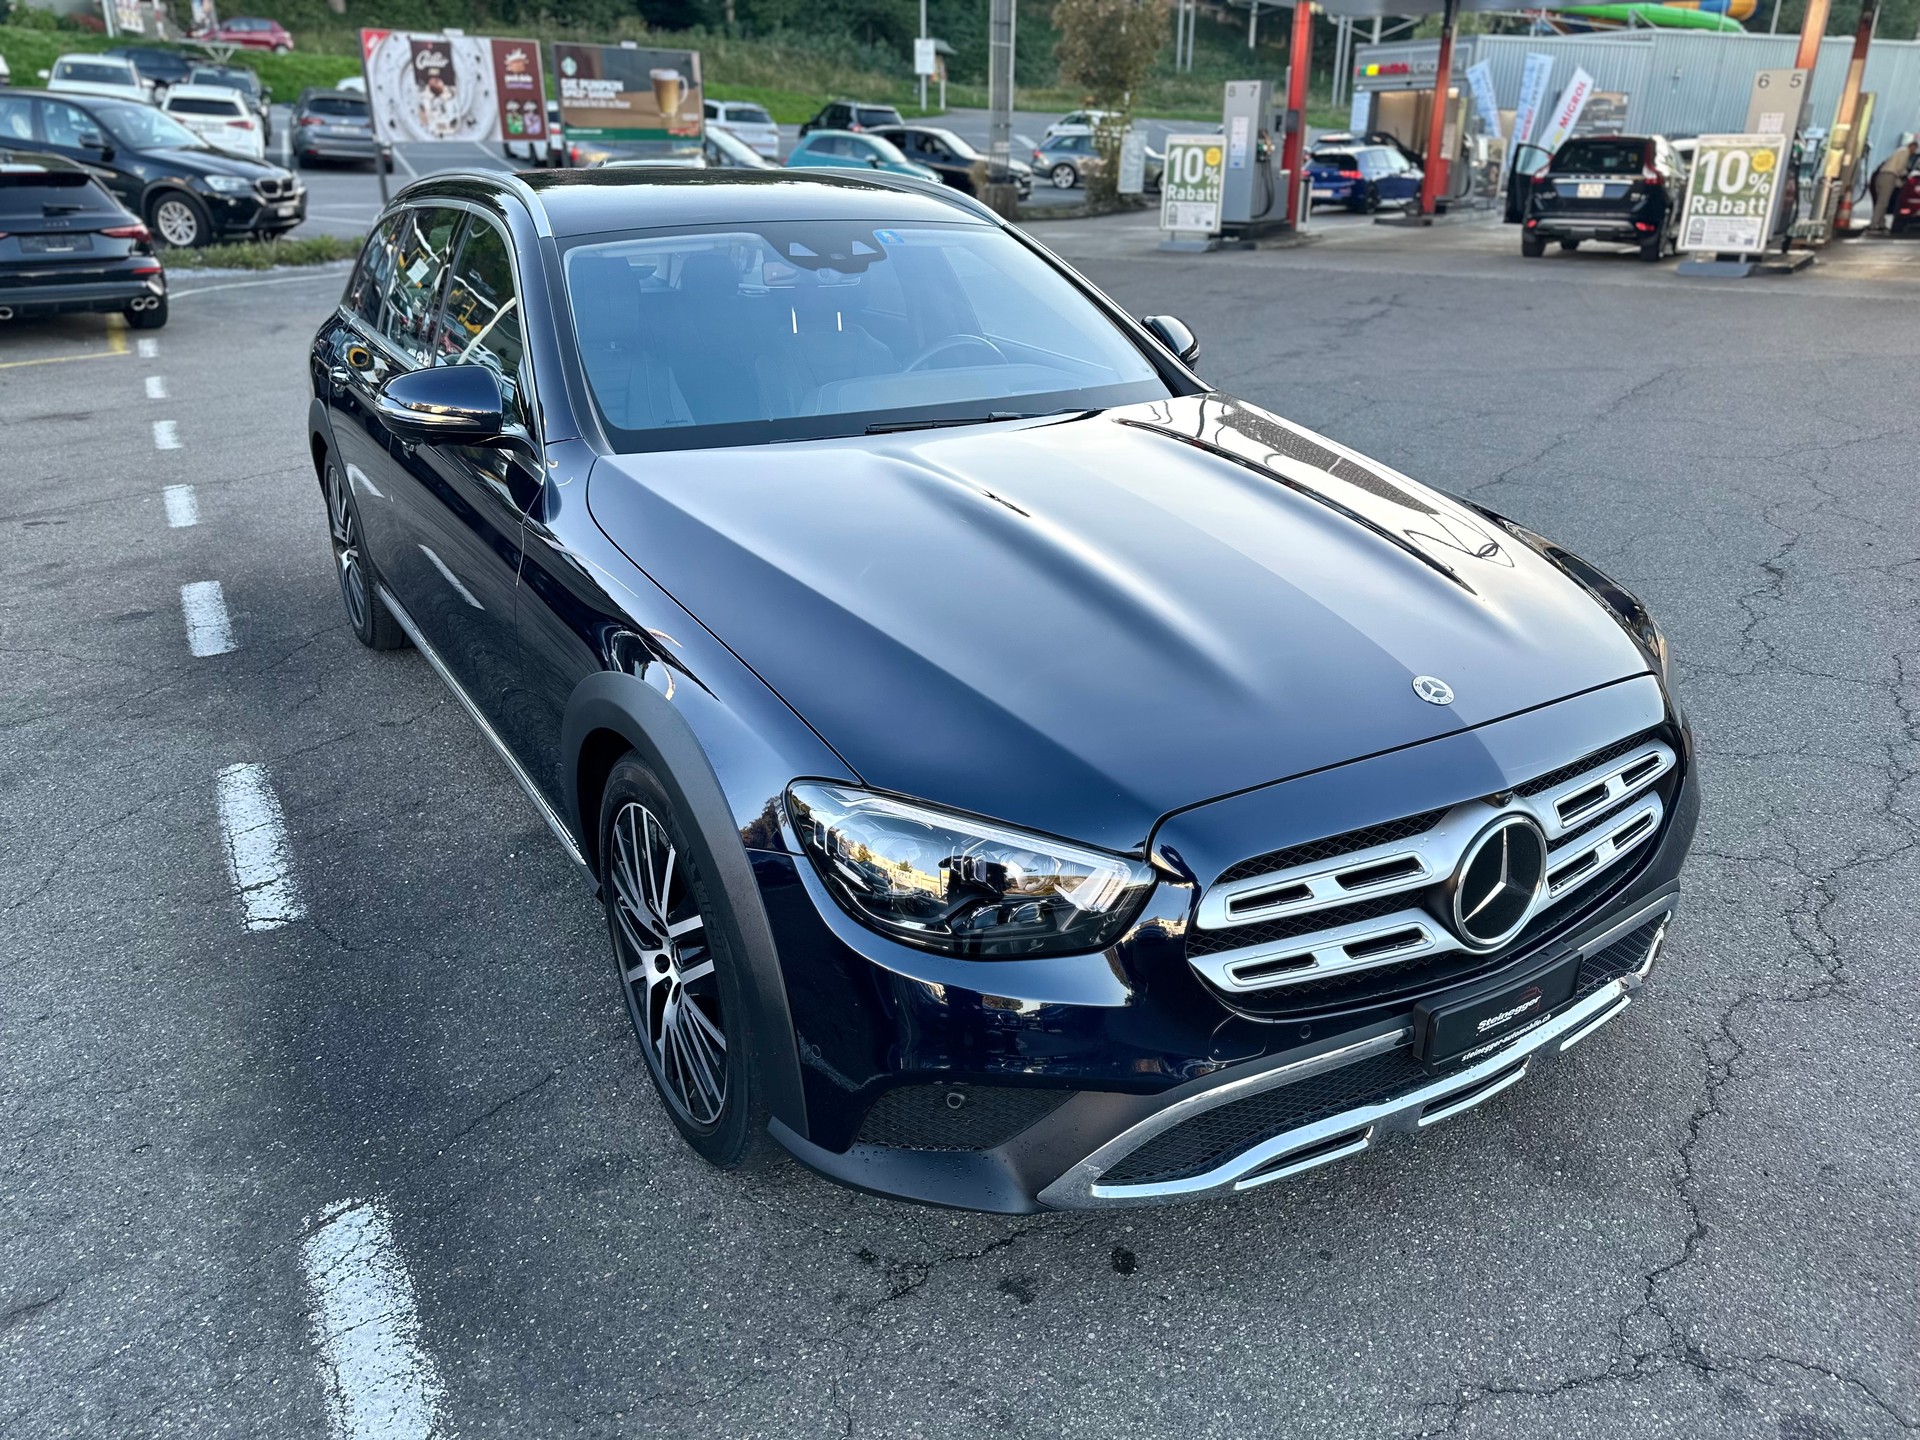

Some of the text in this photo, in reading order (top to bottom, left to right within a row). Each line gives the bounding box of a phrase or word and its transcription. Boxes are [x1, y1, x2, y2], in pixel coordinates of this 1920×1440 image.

[1757, 73, 1802, 89] 6 5
[1249, 85, 1258, 97] 7
[1559, 81, 1587, 129] MIGROL
[1167, 184, 1218, 201] Rabatt
[1691, 195, 1767, 215] Rabatt
[1477, 995, 1541, 1030] Steinegger
